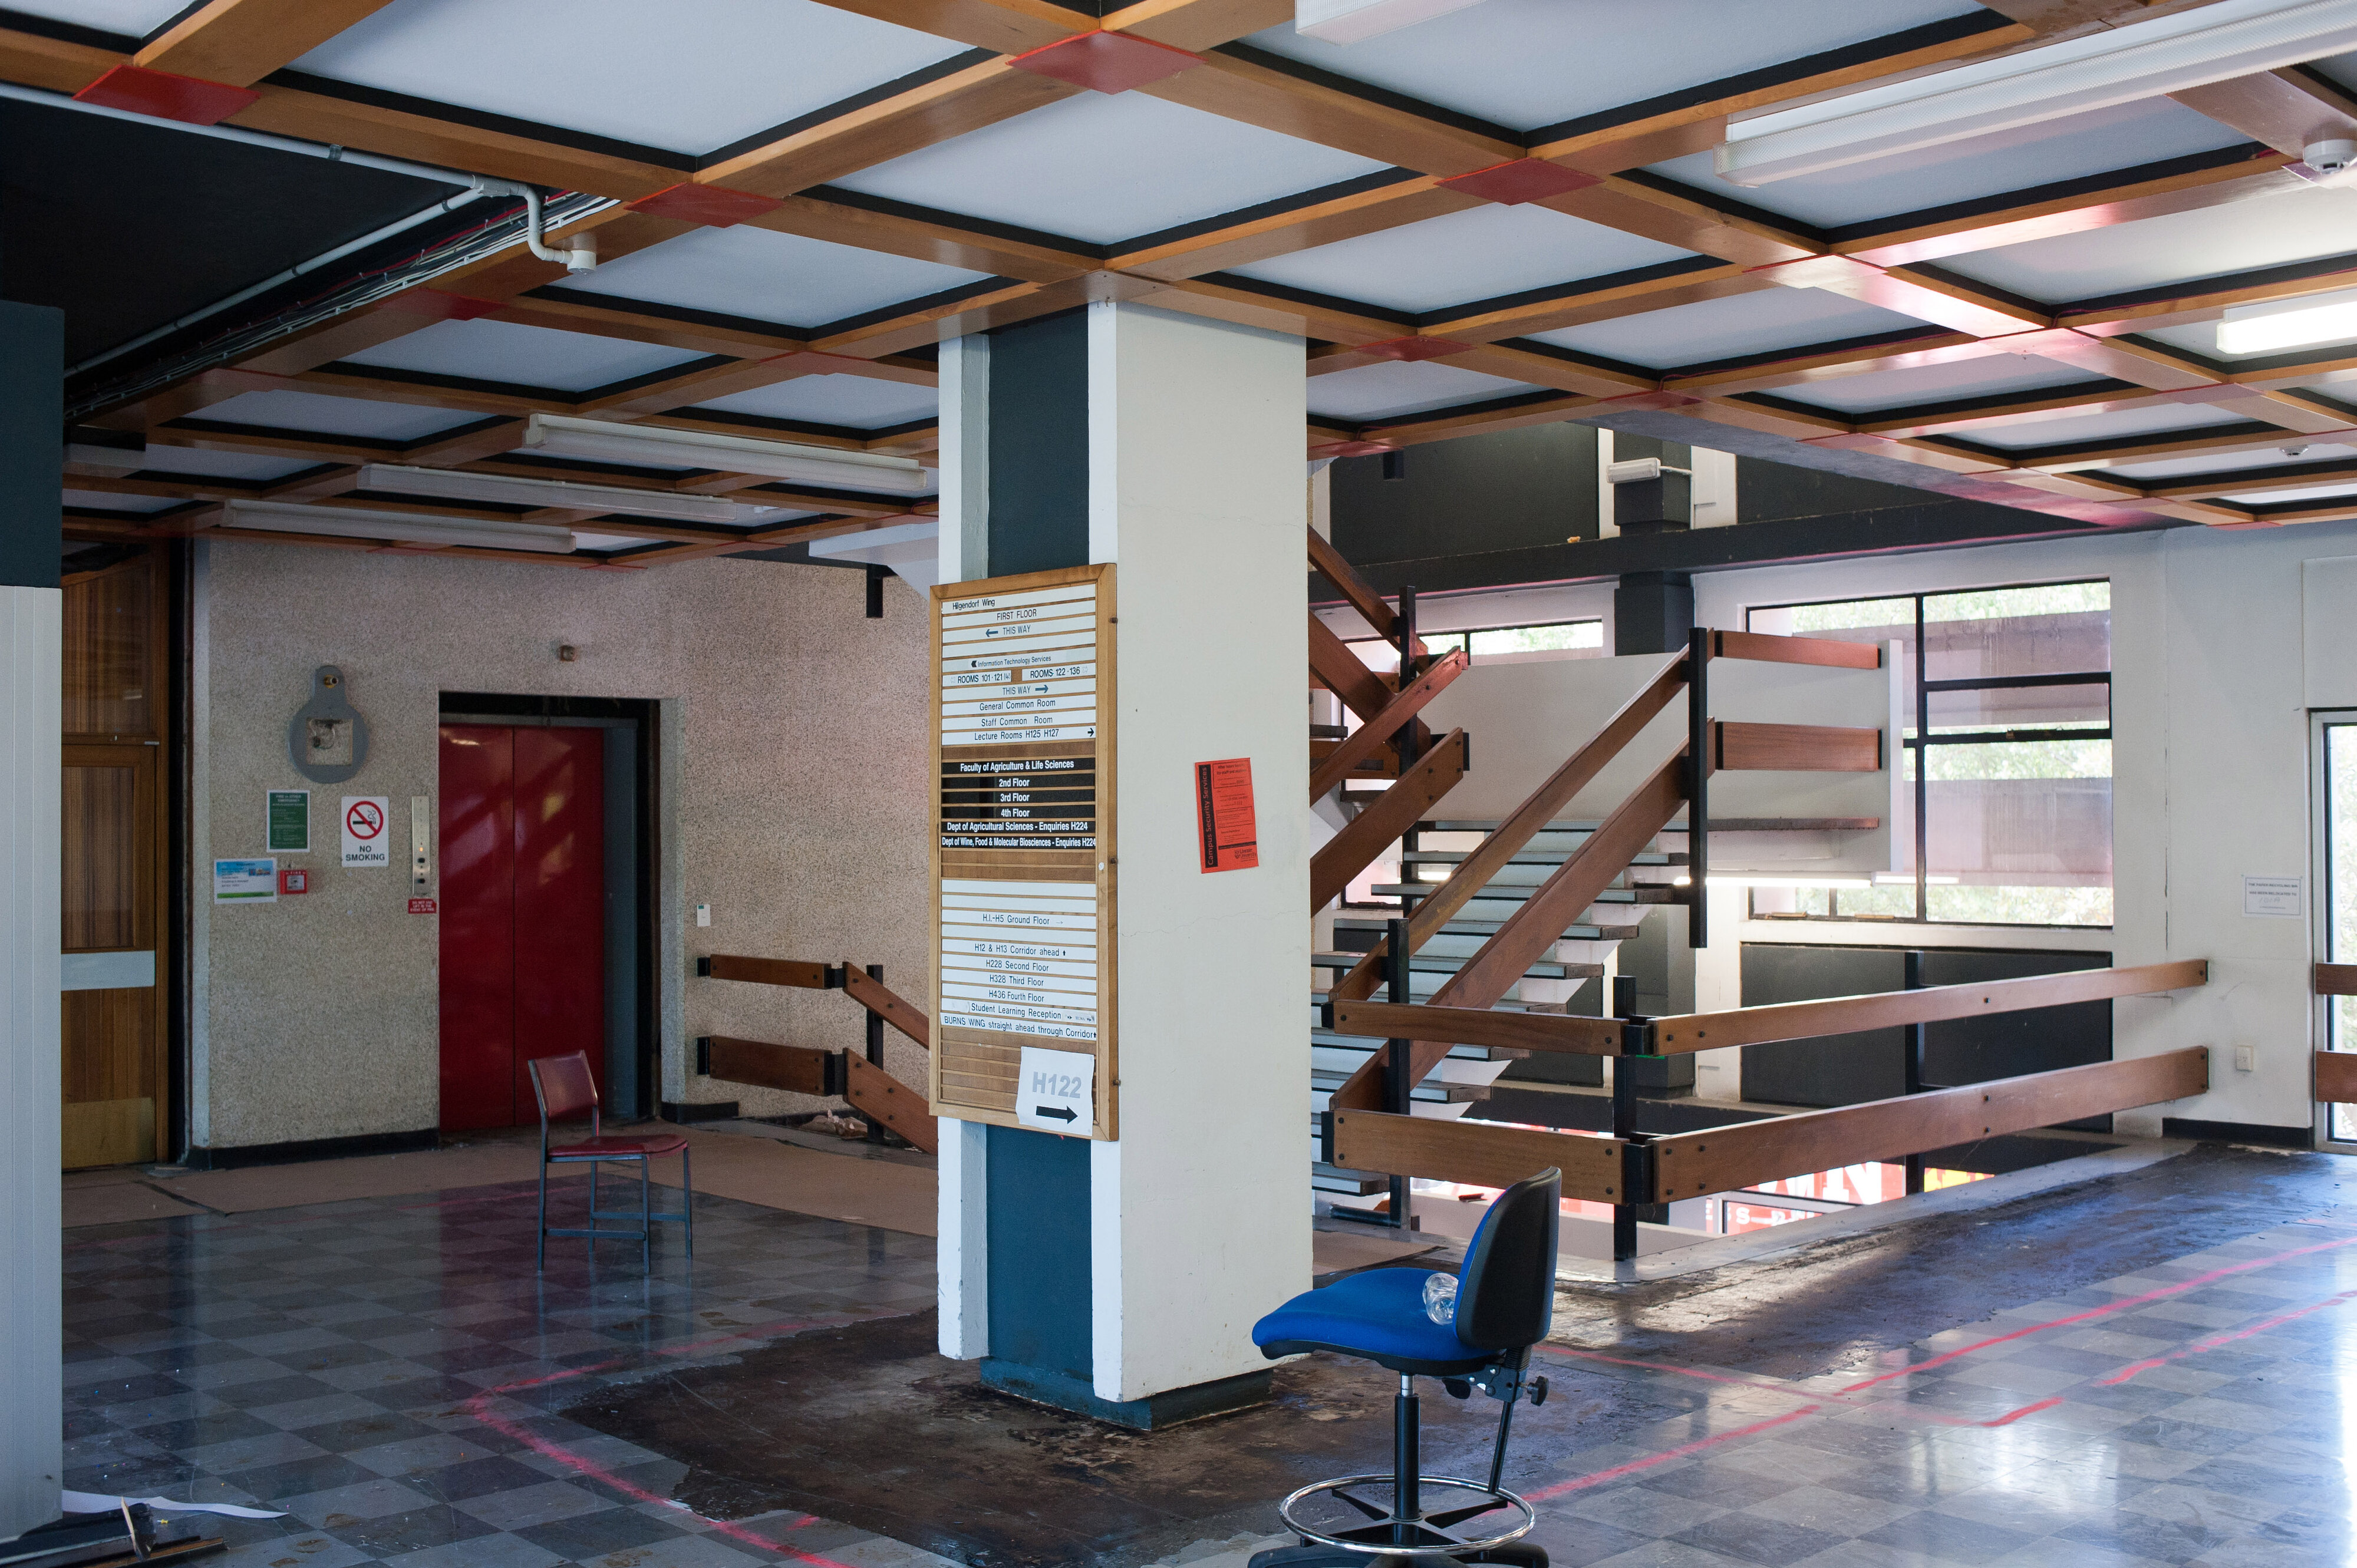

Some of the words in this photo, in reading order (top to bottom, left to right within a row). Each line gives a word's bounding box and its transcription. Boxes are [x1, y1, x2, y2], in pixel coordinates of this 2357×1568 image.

[952, 600, 980, 610] Hilgendorf
[982, 599, 995, 607] Wing
[997, 611, 1014, 620] FIRST
[1017, 609, 1037, 619] FLOOR
[1003, 626, 1016, 636] THIS
[1017, 625, 1031, 635] WAY
[1004, 657, 1030, 665] Technology
[957, 674, 979, 684] ROOMS
[1030, 669, 1053, 678] ROOMS
[1003, 687, 1016, 695] THIS
[1017, 685, 1031, 694] WAY
[980, 702, 1003, 711] General
[1006, 701, 1034, 709] Common
[1037, 699, 1056, 708] Room
[981, 718, 997, 727] Staff
[1000, 717, 1027, 725] Common
[1034, 715, 1053, 724] Room
[974, 732, 997, 741] Lecture
[1001, 731, 1023, 739] Rooms
[1026, 729, 1041, 738] H125
[1044, 728, 1059, 737] H127
[960, 762, 981, 773] Faculty
[983, 762, 990, 771] of
[990, 761, 1024, 773] Agriculture
[1025, 761, 1030, 770] &
[1031, 761, 1044, 770] Life
[1044, 760, 1074, 769] Sciences
[998, 778, 1011, 787] 2nd
[1013, 778, 1030, 787] Floor
[1000, 793, 1011, 802] 3rd
[1013, 793, 1030, 802] Floor
[1001, 808, 1011, 817] 4th
[1013, 808, 1030, 817] Floor
[1203, 801, 1211, 832] Security
[947, 822, 961, 832] Dept
[962, 823, 968, 831] of
[969, 822, 1004, 832] Agricultural
[1006, 822, 1033, 831] Sciences
[1039, 821, 1070, 832] Enquiries
[1071, 821, 1088, 830] H224
[942, 837, 954, 847] Dept
[954, 837, 960, 846] of
[960, 837, 974, 847] Wine,
[975, 837, 988, 846] Food
[988, 837, 993, 846] &
[994, 837, 1018, 846] Molecular
[1020, 837, 1051, 847] Biosciences
[1056, 837, 1081, 849] Enquiries
[1082, 838, 1096, 847] H224
[345, 853, 385, 861] SMOKING
[1007, 915, 1030, 924] Ground
[1033, 916, 1050, 925] Floor
[975, 943, 986, 952] H12
[988, 944, 993, 952] &
[996, 945, 1007, 953] H13
[1010, 945, 1036, 955] Corridor
[1040, 948, 1060, 956] ahead
[986, 959, 1002, 968] H228
[1005, 960, 1030, 970] Second
[1032, 963, 1049, 972] Floor
[990, 974, 1006, 983] H328
[1009, 975, 1025, 985] Third
[1027, 977, 1044, 986] Floor
[988, 990, 1006, 999] H436
[1007, 991, 1026, 1001] Fourth
[1028, 993, 1044, 1002] Floor
[971, 1003, 995, 1013] Student
[998, 1005, 1026, 1017] Learning
[1028, 1008, 1062, 1019] Reception
[944, 1016, 966, 1025] BURNS
[968, 1018, 985, 1027] WING
[988, 1020, 1013, 1031] straight
[1015, 1024, 1035, 1033] ahead
[1038, 1025, 1063, 1037] through
[1066, 1028, 1093, 1038] Corridor
[1032, 1071, 1082, 1099] H122
